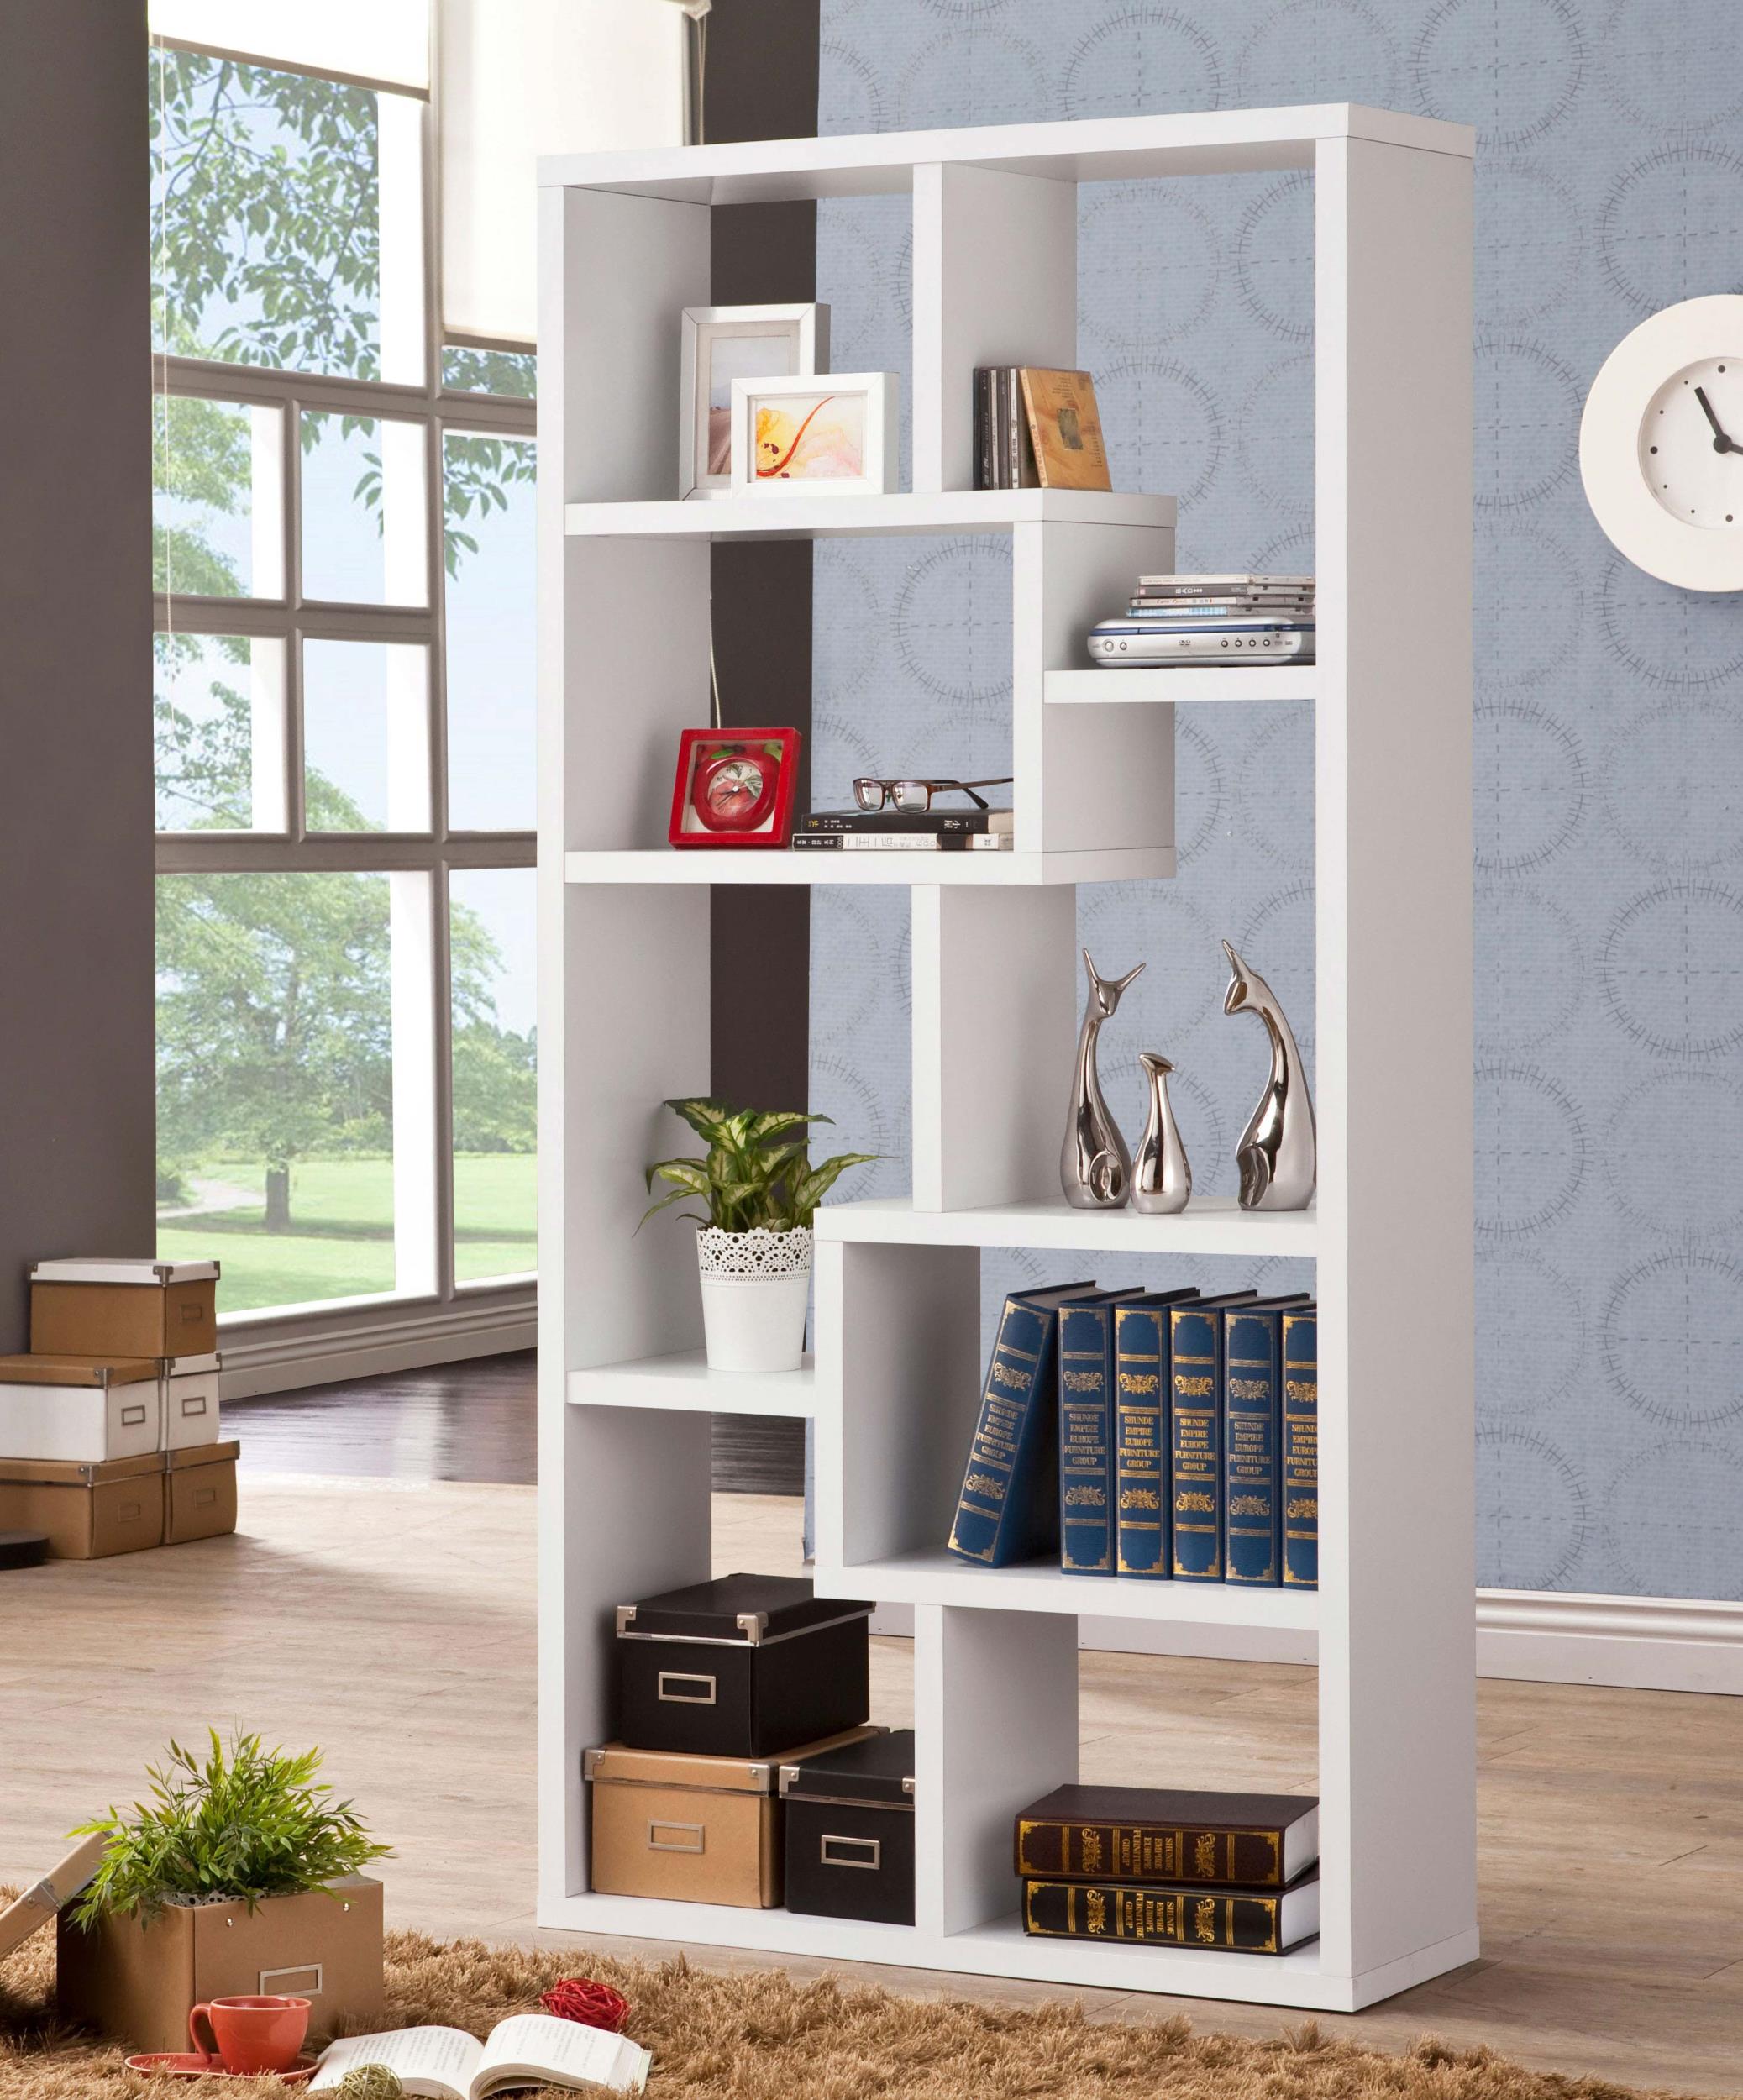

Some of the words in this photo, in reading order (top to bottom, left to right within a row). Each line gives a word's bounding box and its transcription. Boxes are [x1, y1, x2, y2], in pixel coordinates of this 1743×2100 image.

[1068, 1413, 1100, 1422] SHUNDE
[1124, 1415, 1154, 1425] SHUNDE
[1179, 1417, 1210, 1427] SHUNDE
[1069, 1424, 1099, 1433] EMPIRE
[1125, 1426, 1153, 1436] EMPIRE
[1234, 1421, 1264, 1431] SHUNDE
[1291, 1424, 1318, 1433] SHUND
[1180, 1429, 1209, 1438] EMPIRE
[1235, 1432, 1264, 1441] EMPIRE
[1069, 1435, 1100, 1444] EUROPE
[1125, 1437, 1154, 1446] EUROPE
[1179, 1439, 1210, 1449] EUROPE
[1292, 1435, 1318, 1444] EMPIR
[981, 1446, 1005, 1459] GROUP
[1064, 1445, 1106, 1455] FURNITURE
[1119, 1447, 1160, 1458] FURNITURE
[1235, 1443, 1264, 1453] EUROPE
[1292, 1446, 1318, 1455] EUROP
[1175, 1450, 1216, 1461] FURNITURE
[1229, 1453, 1271, 1464] FURNITURE
[1072, 1457, 1097, 1466] GROUP
[1126, 1459, 1152, 1468] GROUP
[1286, 1456, 1318, 1466] FURNITU
[1182, 1462, 1207, 1471] GROUP
[1236, 1465, 1263, 1475] GROUP
[1121, 1838, 1131, 1866] GROUP
[1132, 1830, 1142, 1876] FURNITURE
[1143, 1836, 1152, 1870] EUROPE
[1154, 1837, 1163, 1870] EMPIRE
[1165, 1837, 1173, 1871] SHUNDE
[1136, 1893, 1144, 1940] FURNITURE
[1146, 1900, 1154, 1934] EUROPE
[1156, 1901, 1164, 1934] EMPIRE
[1166, 1901, 1175, 1935] SHUNDE
